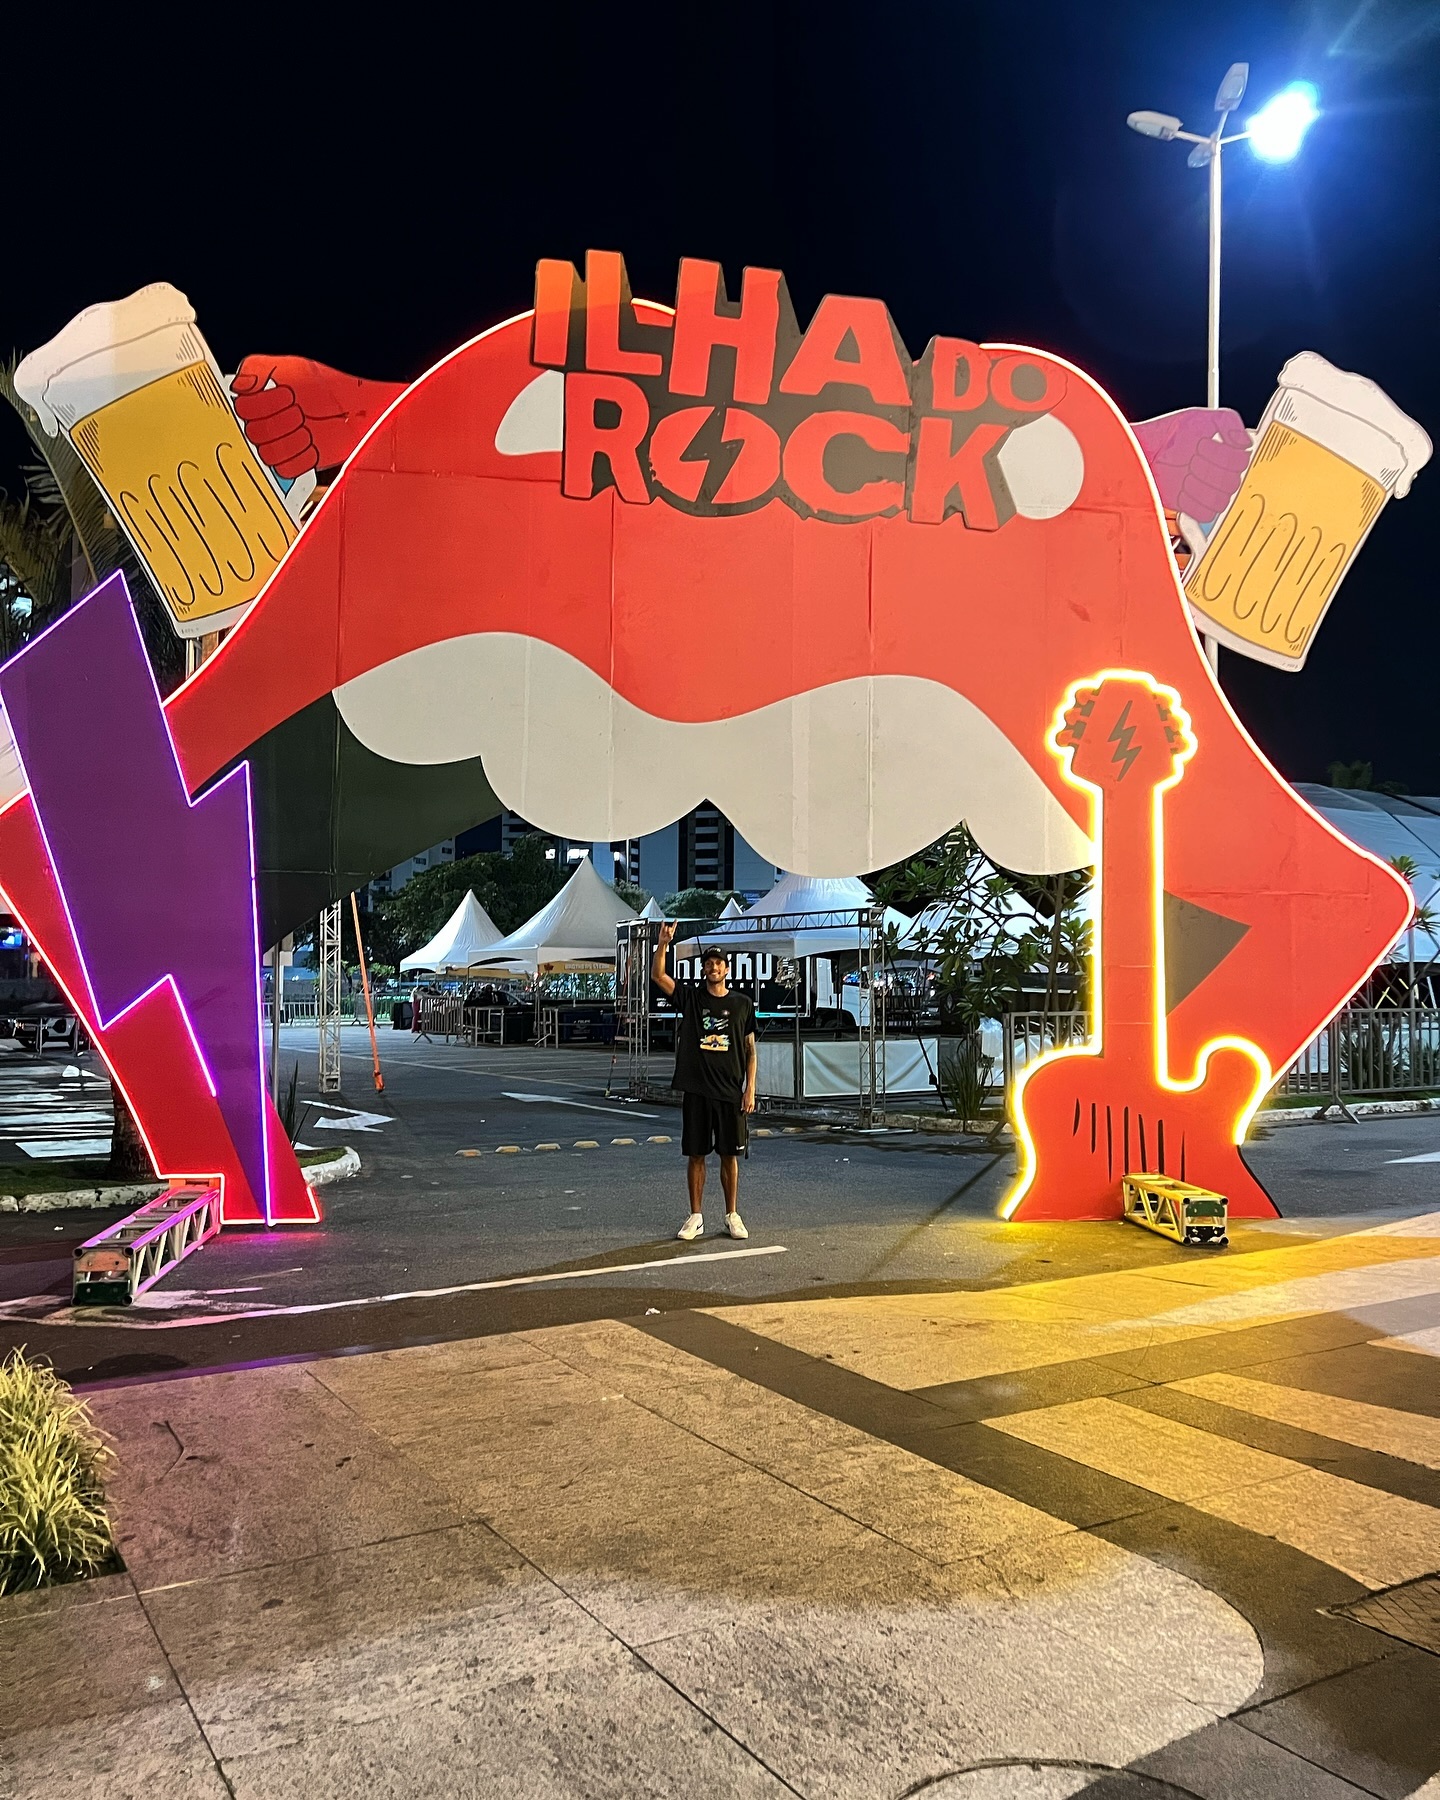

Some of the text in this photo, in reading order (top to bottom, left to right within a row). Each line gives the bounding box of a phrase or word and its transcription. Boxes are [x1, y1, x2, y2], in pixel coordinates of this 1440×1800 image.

[532, 249, 1067, 412] ILHA DO
[563, 371, 1010, 531] ROCK
